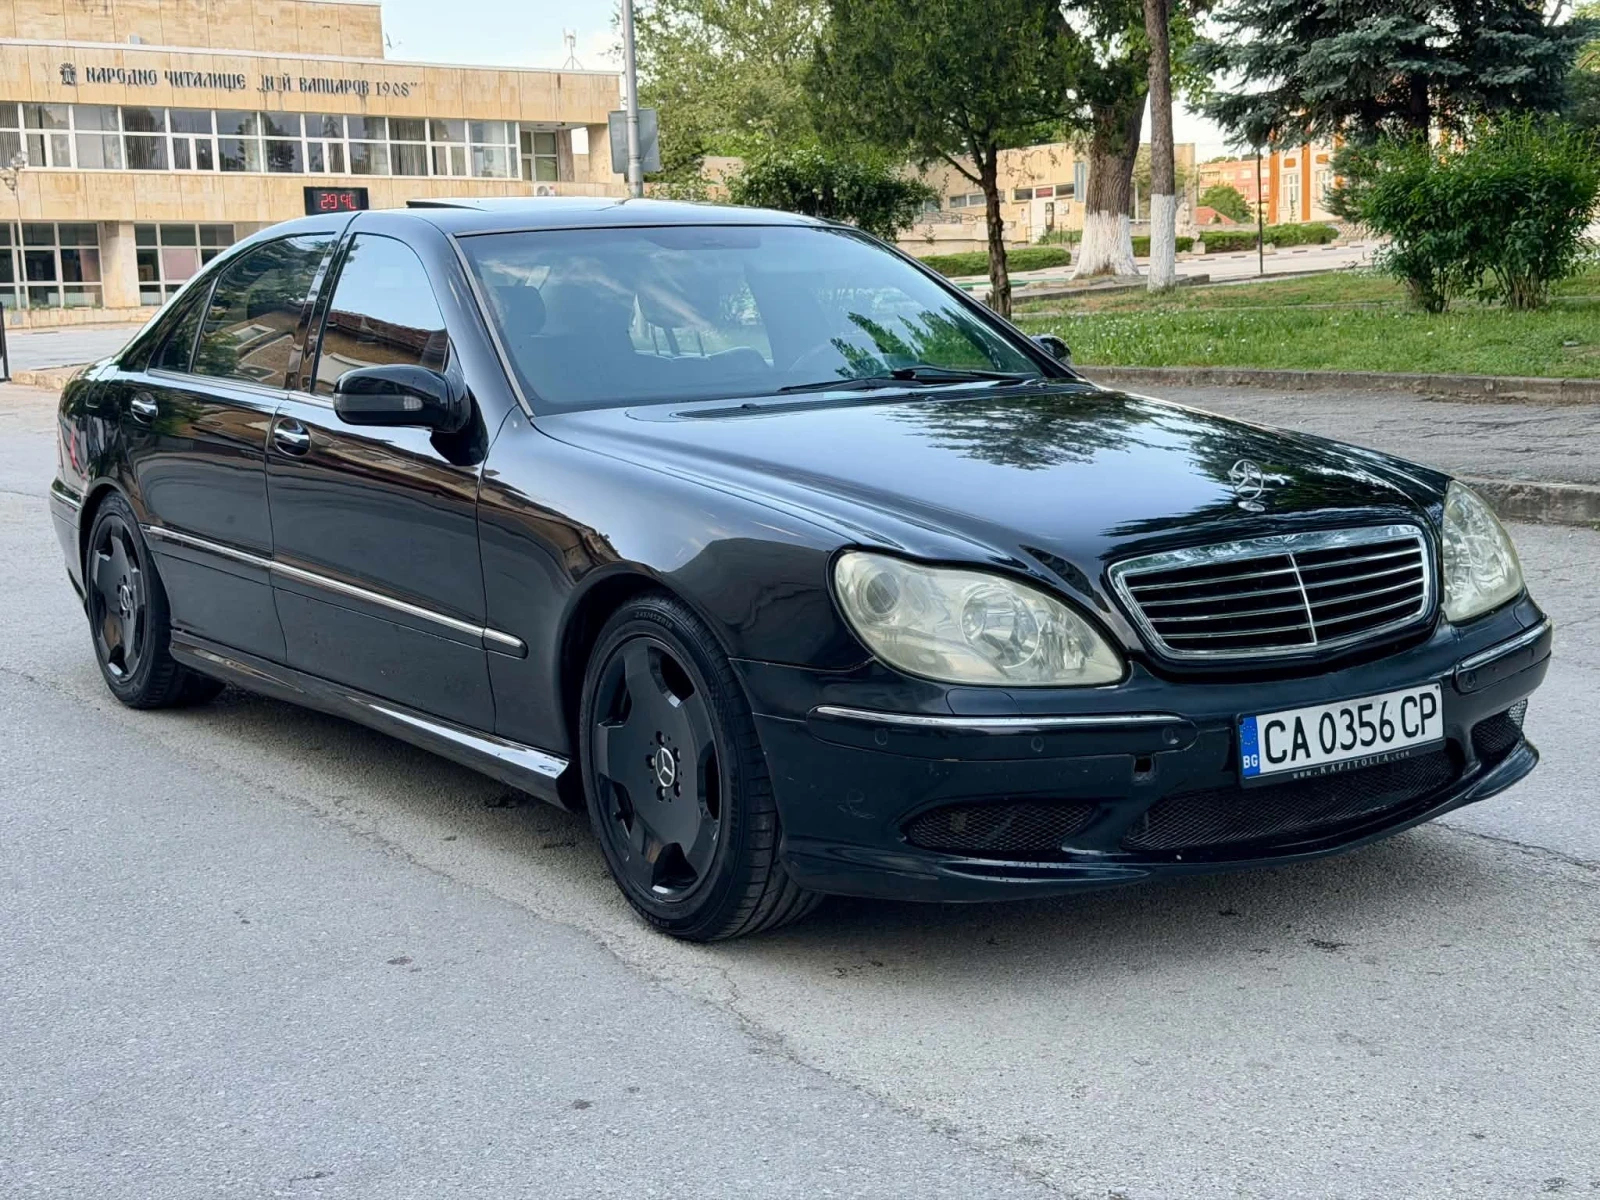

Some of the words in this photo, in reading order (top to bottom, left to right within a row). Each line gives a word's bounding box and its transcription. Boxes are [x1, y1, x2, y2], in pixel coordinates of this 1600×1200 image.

[86, 67, 157, 86] НАРОДНО
[164, 70, 246, 92] ЧИТАЛИЩЕ
[299, 77, 369, 96] ВАПЦАРОВ
[1264, 716, 1312, 764] CA
[1319, 701, 1395, 755] 0356
[1400, 692, 1437, 739] CP
[1243, 754, 1258, 769] BG
